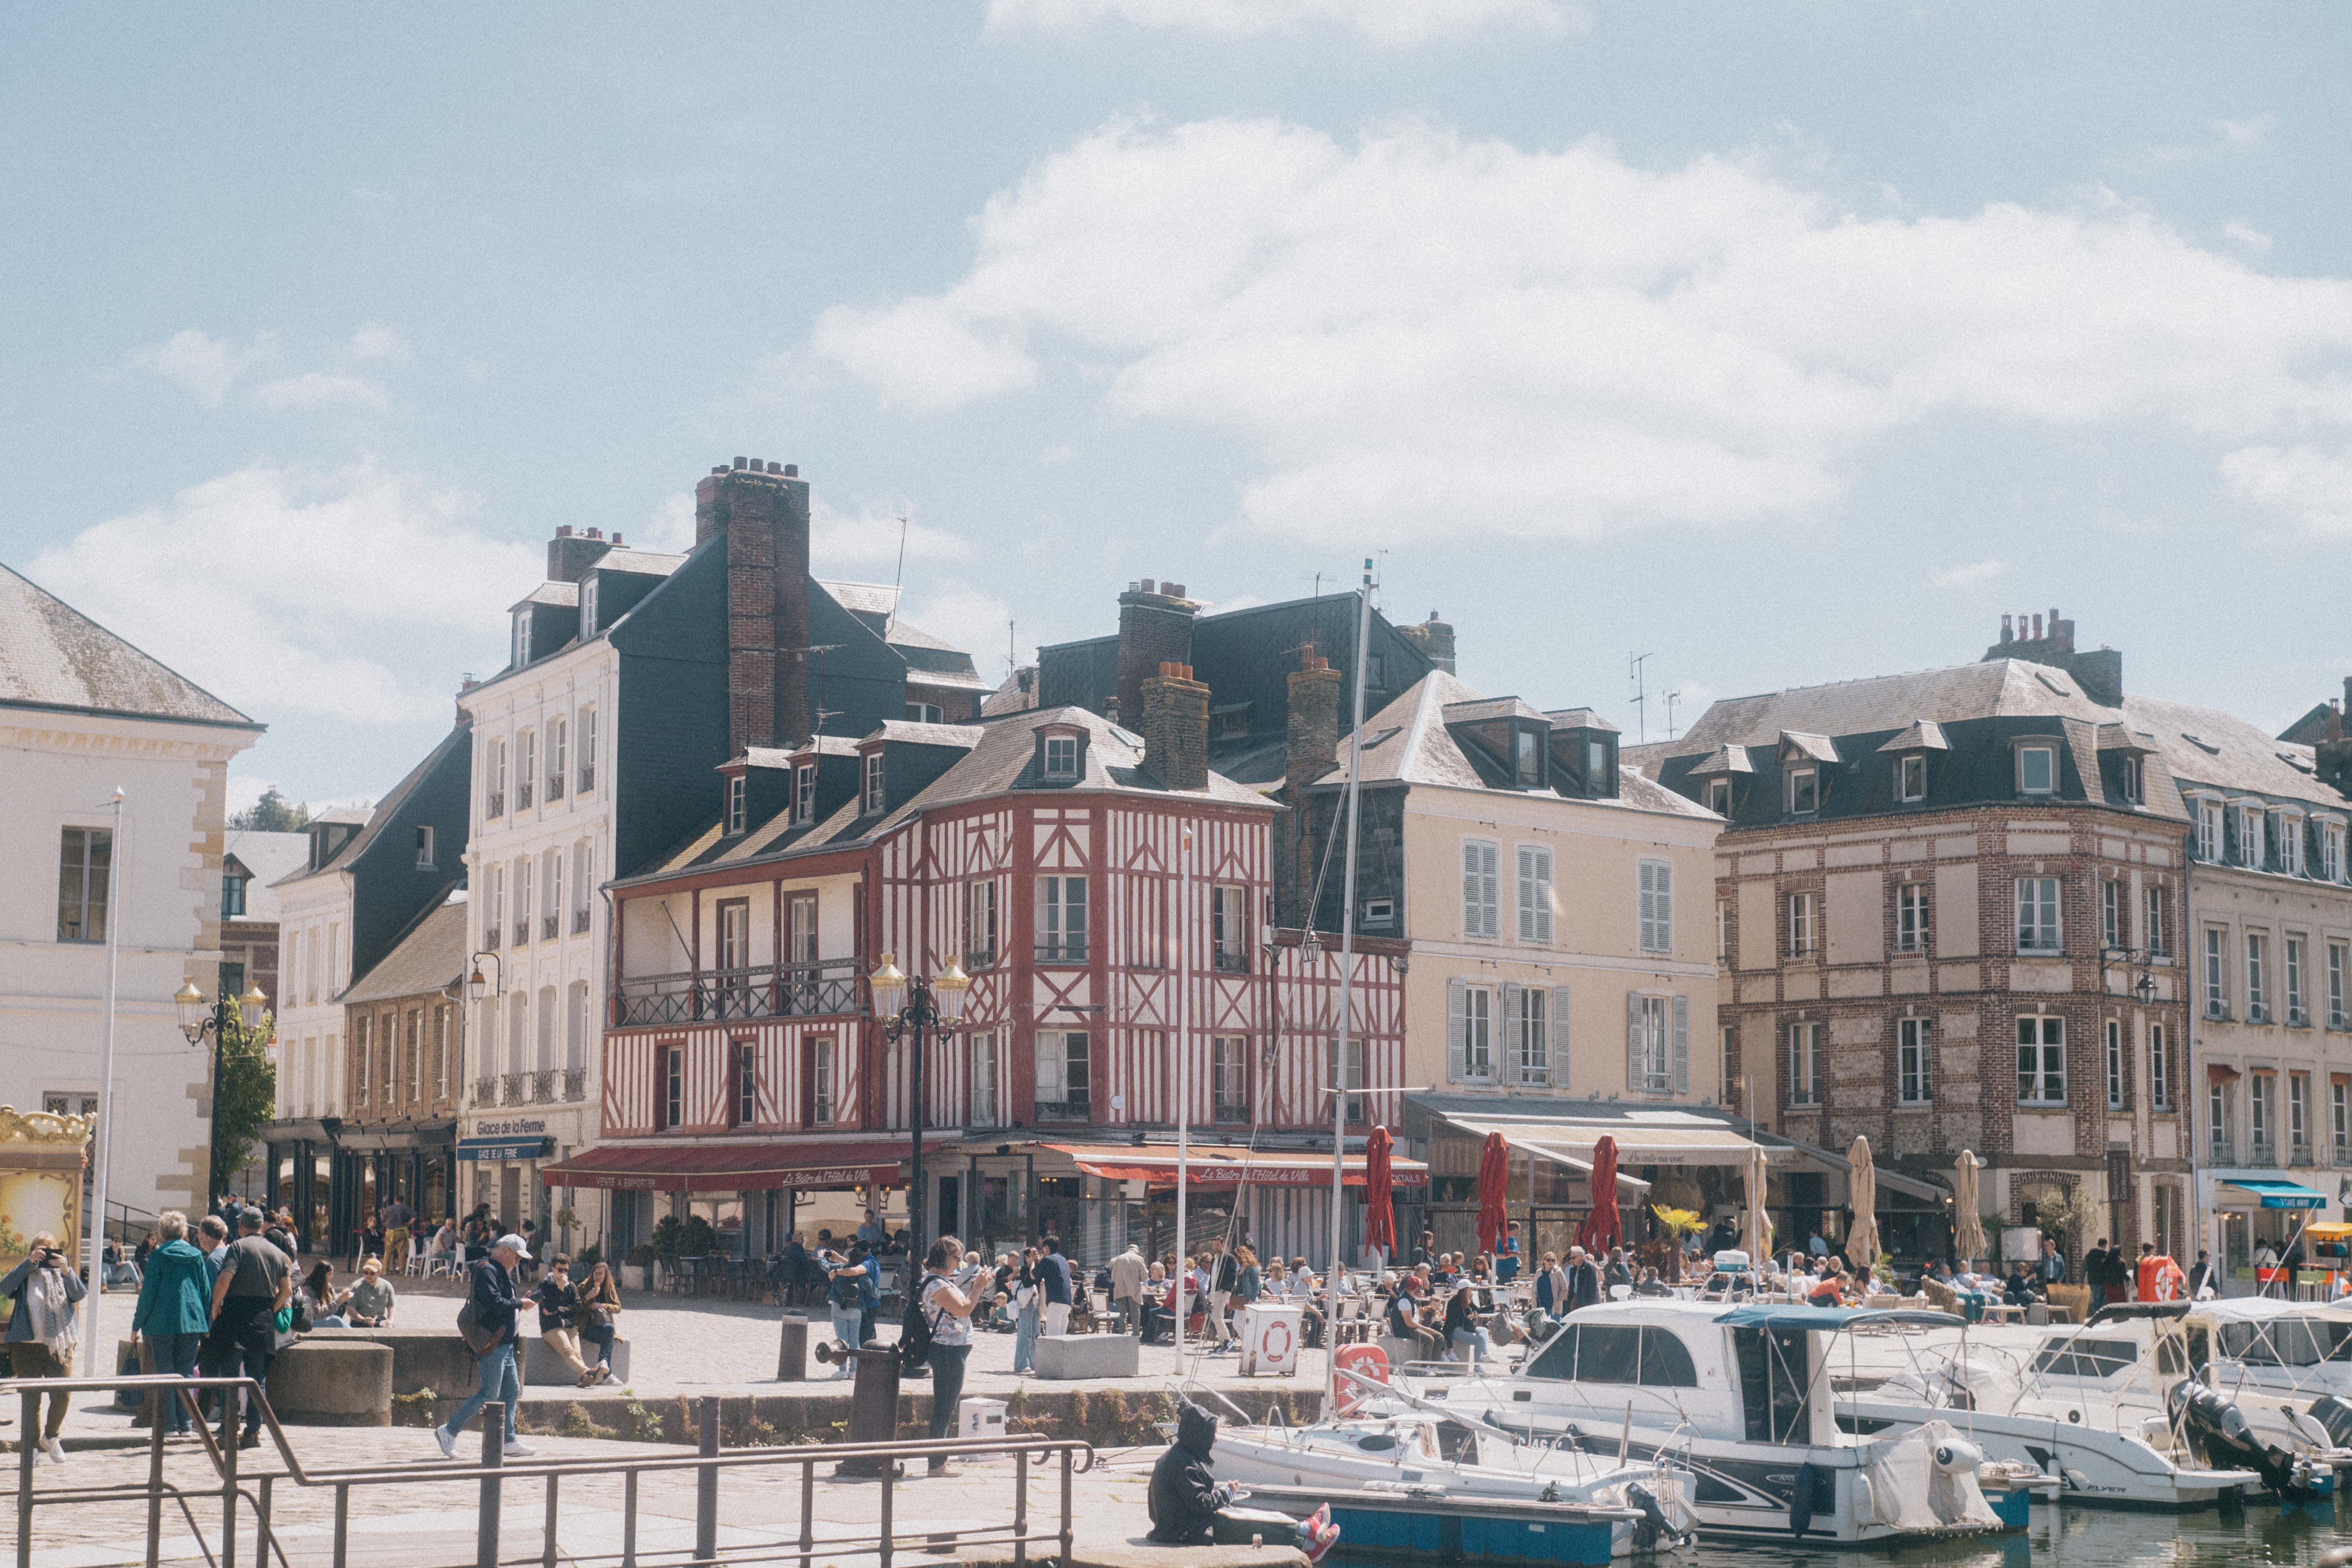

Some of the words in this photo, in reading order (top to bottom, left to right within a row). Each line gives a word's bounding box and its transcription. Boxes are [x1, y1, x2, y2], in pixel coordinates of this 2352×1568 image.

[477, 1121, 499, 1135] Glace
[501, 1121, 511, 1134] de
[513, 1120, 519, 1133] la
[521, 1119, 545, 1132] Ferme
[478, 1150, 490, 1159] GLACE
[491, 1150, 496, 1158] DE
[497, 1149, 502, 1158] LA
[504, 1148, 517, 1158] FERME
[1628, 1151, 1639, 1163] La
[783, 1173, 793, 1184] Le
[795, 1172, 813, 1183] Bistro
[815, 1171, 822, 1182] de
[823, 1170, 845, 1182] l'Hôtel
[846, 1169, 853, 1180] de
[854, 1169, 871, 1180] Ville
[1200, 1168, 1213, 1178] Le
[1216, 1168, 1240, 1179] Bistro
[1242, 1169, 1250, 1179] de
[1252, 1169, 1279, 1180] l'Hôtel
[1279, 1170, 1289, 1180] de
[1291, 1170, 1310, 1180] Ville
[596, 1177, 615, 1186] VENTE
[624, 1178, 655, 1188] EMPORTER
[2297, 1199, 2309, 1207] AWAY
[2087, 1485, 2127, 1493] FLYER
